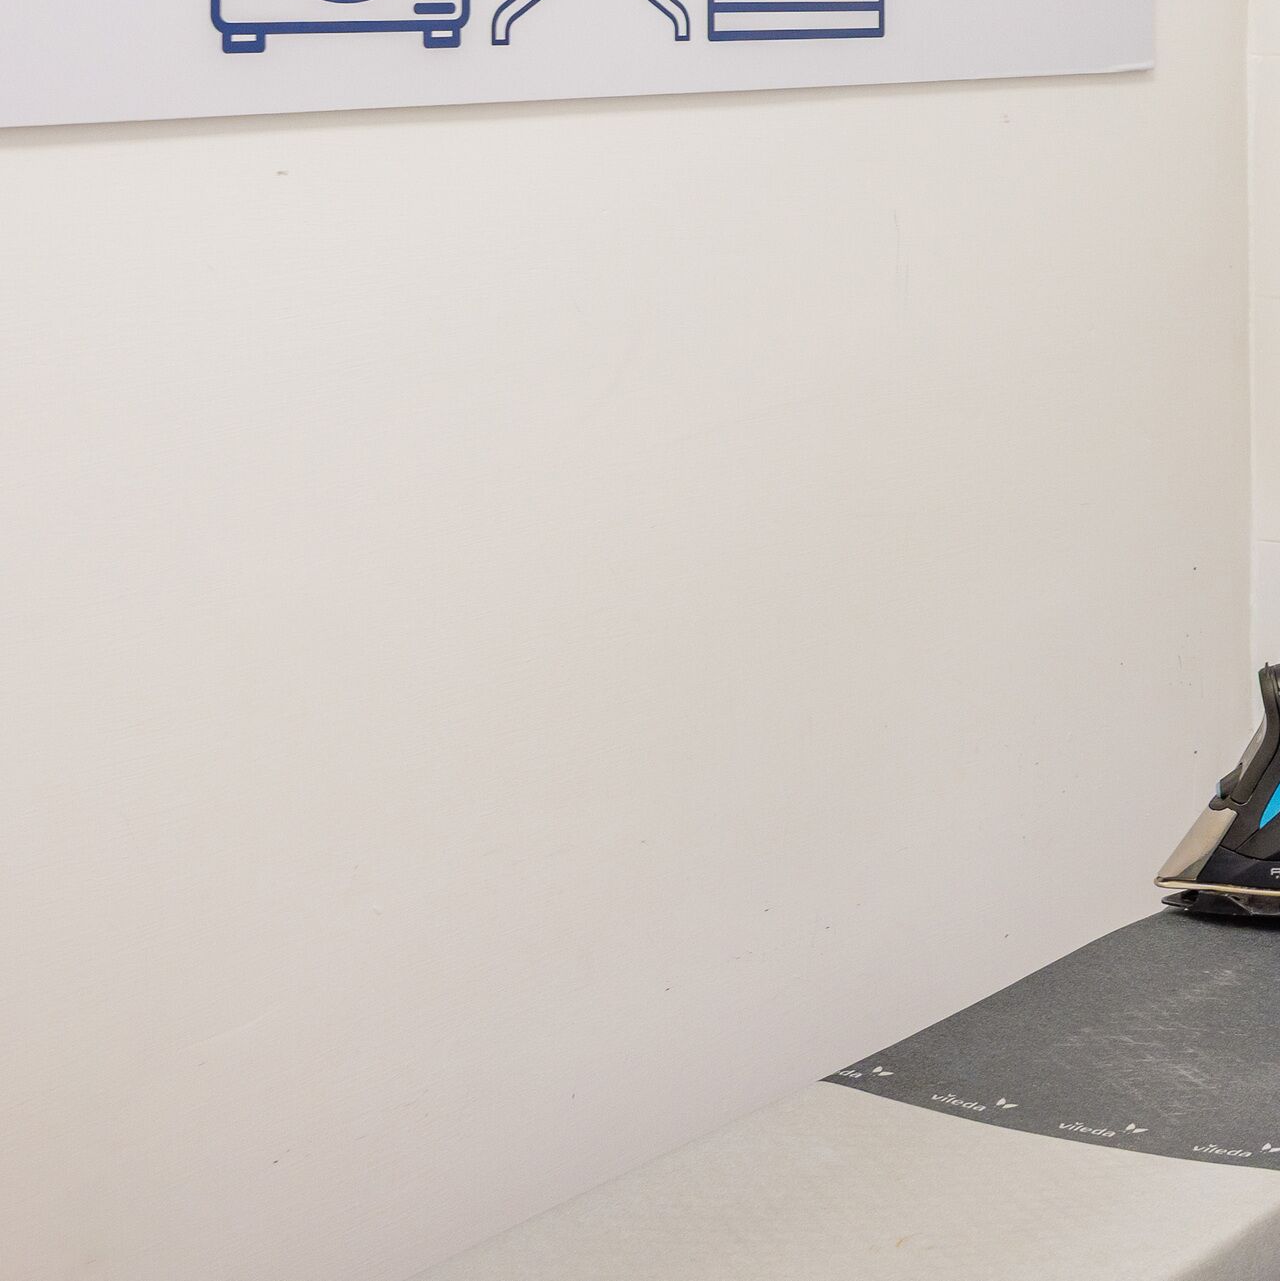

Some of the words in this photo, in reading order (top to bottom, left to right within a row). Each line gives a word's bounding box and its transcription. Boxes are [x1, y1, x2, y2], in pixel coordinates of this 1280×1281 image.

[931, 1093, 987, 1112] vileda
[1058, 1122, 1116, 1138] vileda
[1192, 1143, 1252, 1157] vileda
